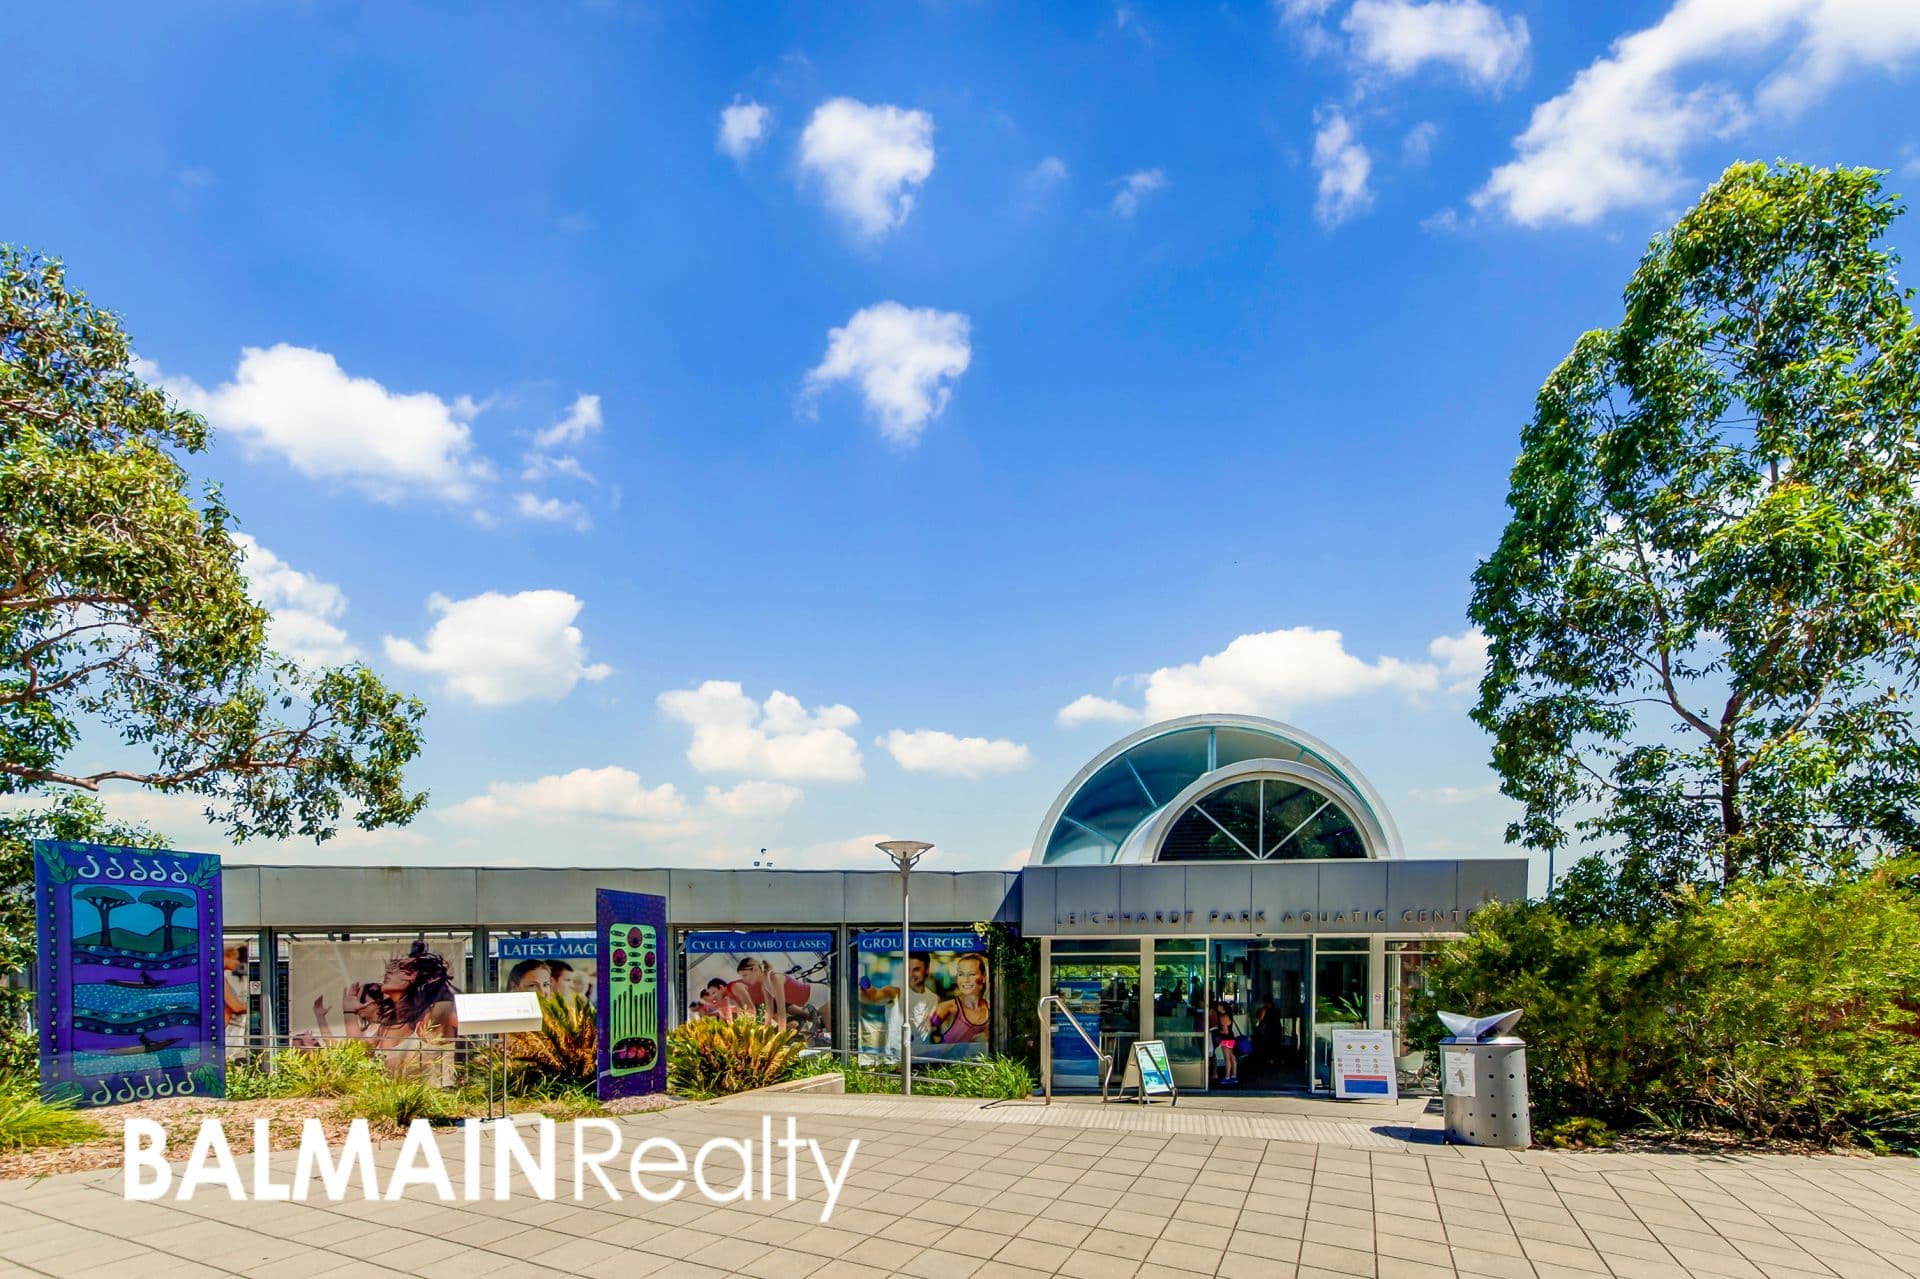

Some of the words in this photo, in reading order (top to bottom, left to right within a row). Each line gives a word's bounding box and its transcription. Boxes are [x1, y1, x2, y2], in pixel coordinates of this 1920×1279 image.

[1055, 909, 1195, 927] LEICHHARDT
[1208, 909, 1266, 926] PARK
[1281, 909, 1385, 926] AQUATIC
[503, 944, 555, 956] LATEST
[558, 943, 597, 955] MAC
[691, 940, 726, 950] CYCLE
[728, 941, 737, 950] &
[739, 940, 783, 950] COMBO
[785, 940, 827, 950] CLASSES
[862, 938, 903, 949] GROU
[913, 938, 974, 949] EXERCISES
